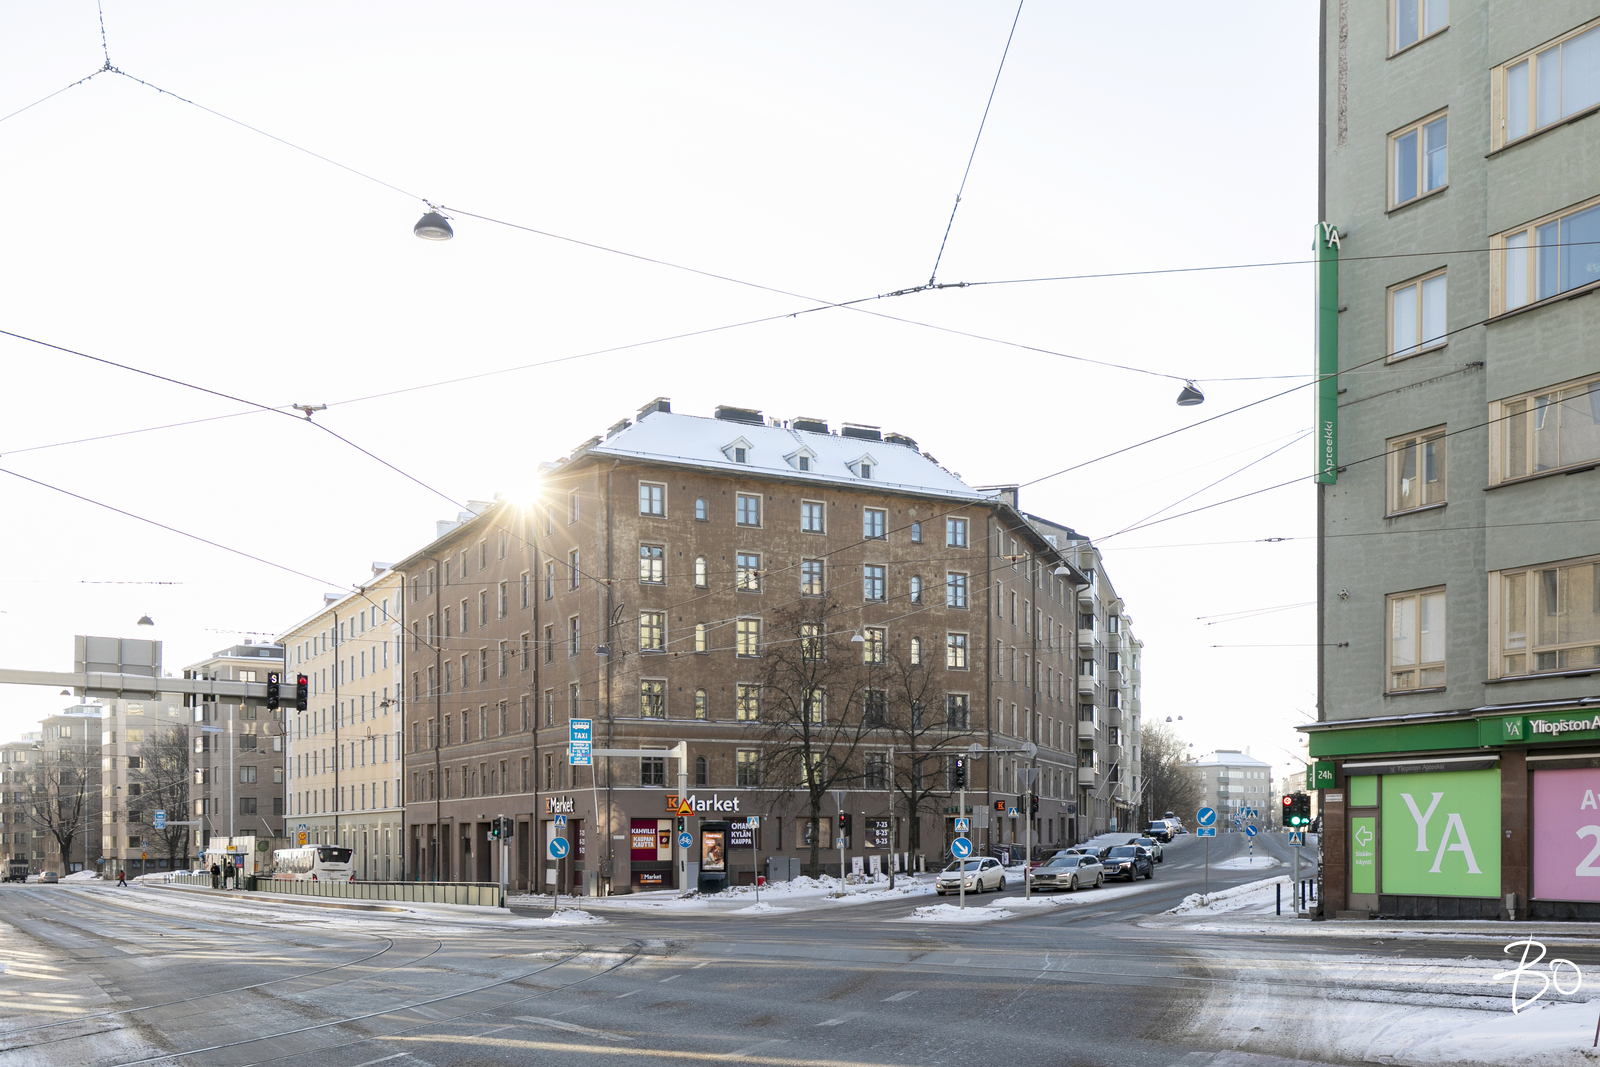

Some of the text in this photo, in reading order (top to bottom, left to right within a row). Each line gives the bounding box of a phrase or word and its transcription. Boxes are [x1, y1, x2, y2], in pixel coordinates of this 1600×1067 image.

[1322, 220, 1340, 250] YA
[1324, 420, 1335, 477] Apteekki
[271, 674, 277, 684] S
[1505, 722, 1520, 736] YA
[1529, 719, 1591, 736] Yliopiston
[1318, 770, 1332, 780] 24h
[550, 795, 574, 813] Market
[1580, 789, 1600, 810] A
[1400, 792, 1483, 874] YA
